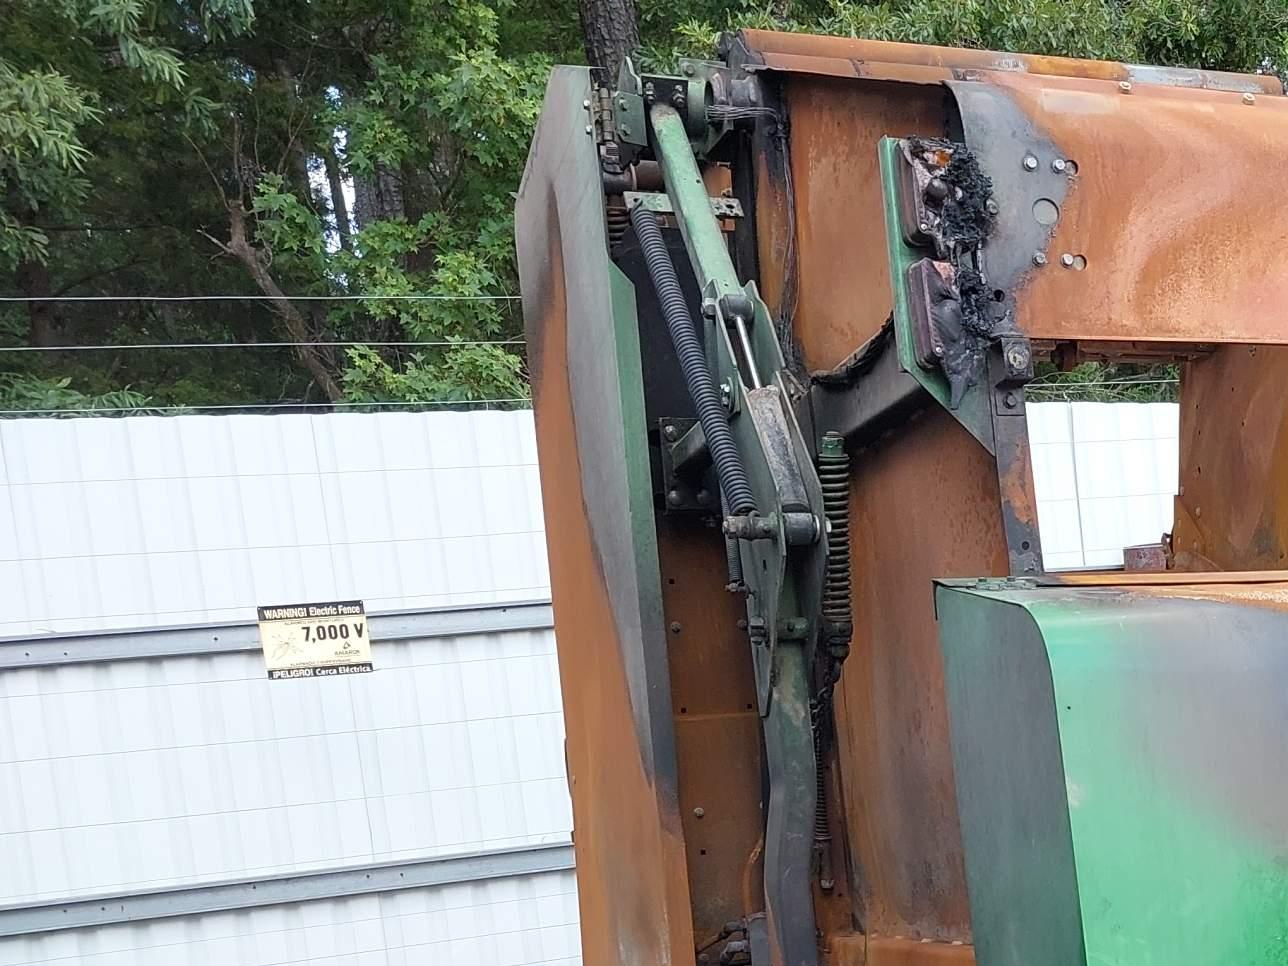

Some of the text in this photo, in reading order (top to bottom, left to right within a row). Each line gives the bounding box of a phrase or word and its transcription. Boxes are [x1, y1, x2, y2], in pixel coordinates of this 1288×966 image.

[263, 604, 360, 619] WARNING! Electric Fence
[301, 622, 364, 643] 7,000 V
[315, 667, 338, 676] Cerca
